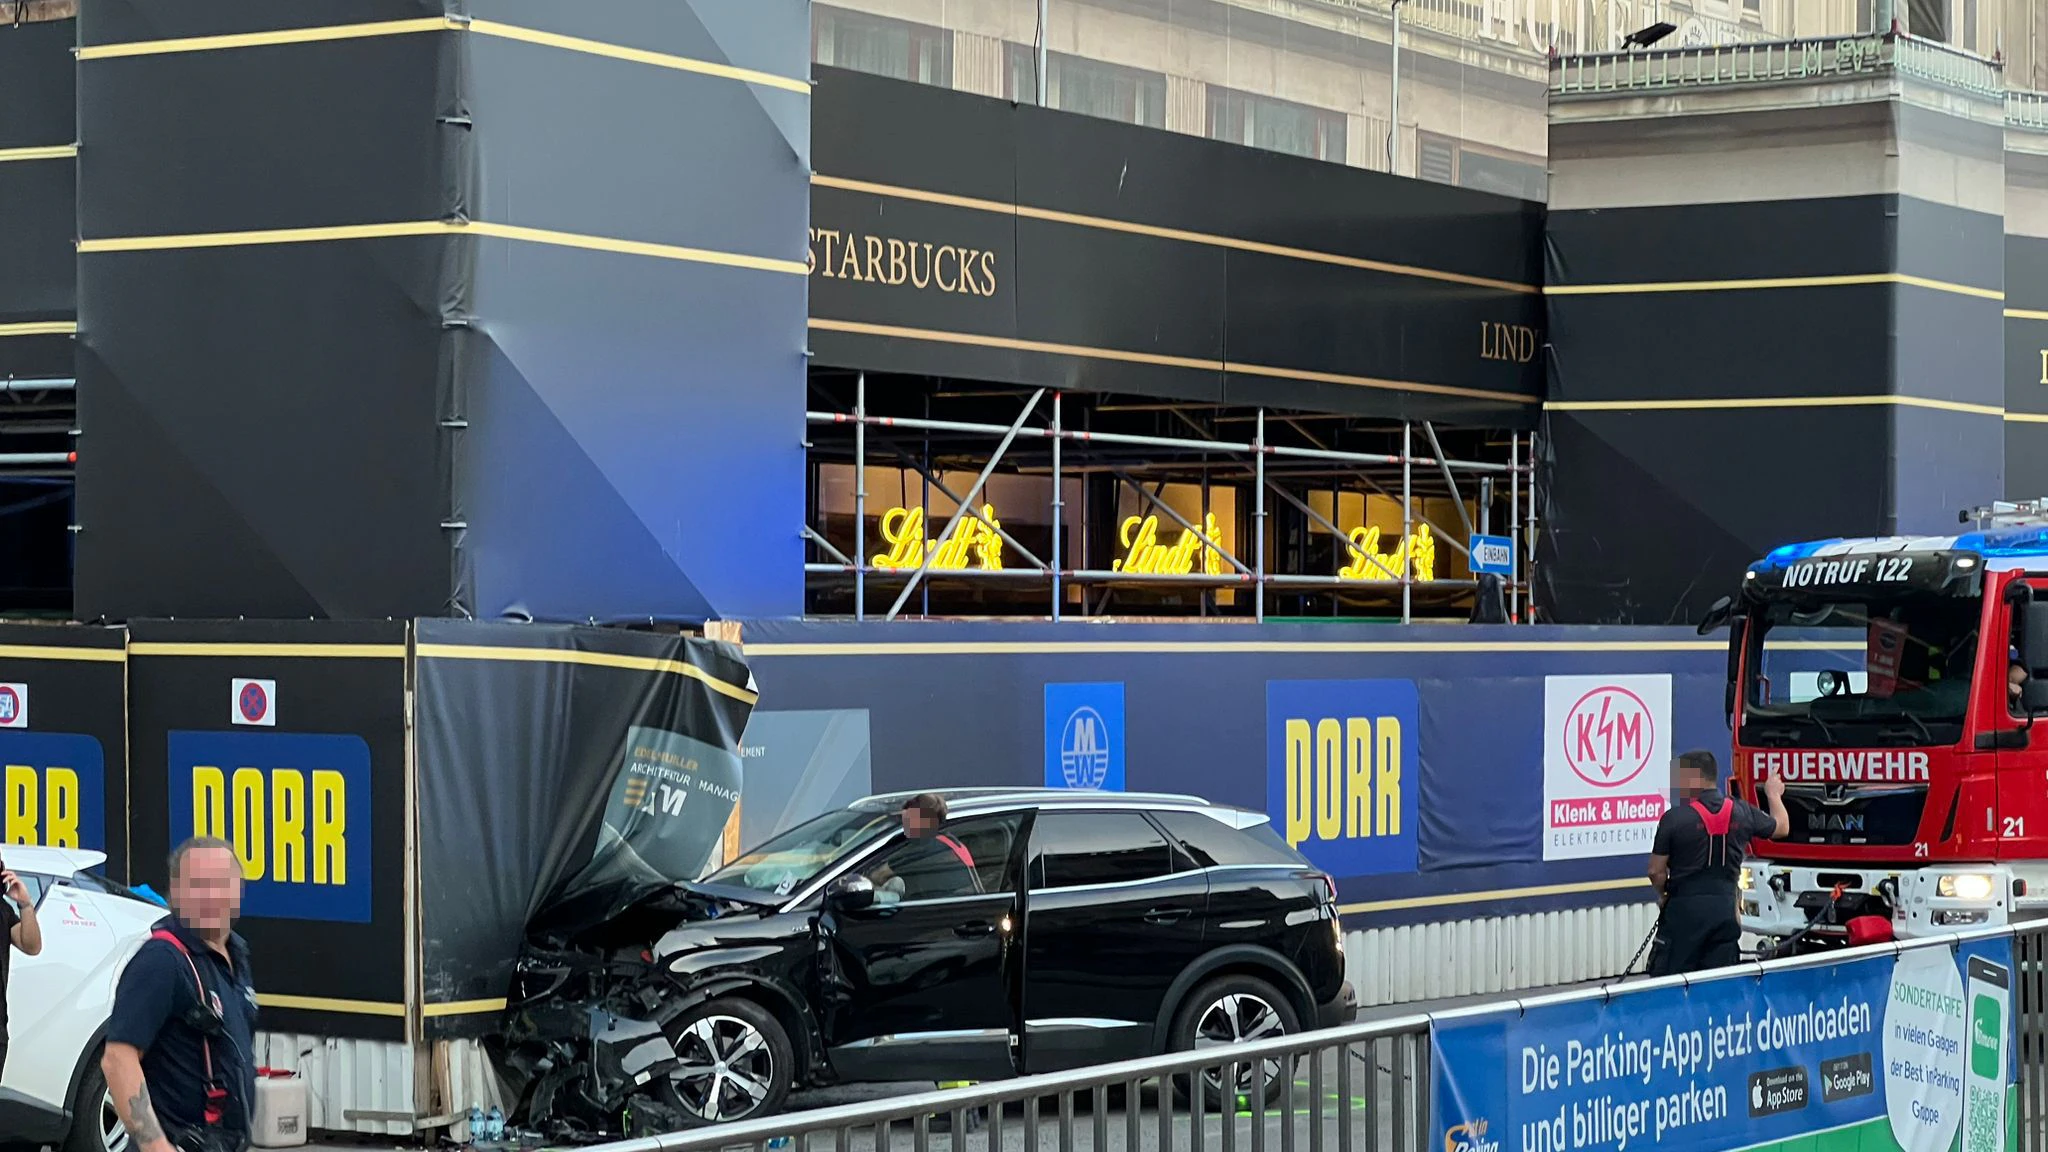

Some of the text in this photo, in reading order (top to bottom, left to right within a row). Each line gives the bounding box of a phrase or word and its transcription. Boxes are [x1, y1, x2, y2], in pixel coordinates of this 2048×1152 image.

[1480, 321, 1539, 362] LIND
[1113, 515, 1202, 575] Lindt
[1484, 546, 1508, 563] EINBAHN
[1782, 557, 1913, 588] NOTRUF 122
[1752, 751, 1930, 781] FEUERWEHR
[1554, 799, 1661, 824] Klenk & Meder
[1808, 813, 1865, 832] MAN
[1554, 827, 1654, 847] ELEKTROTECHNI
[2002, 815, 2025, 838] 21
[1913, 842, 1930, 858] 21
[1522, 996, 1871, 1094] Die Parking-App jetzt downloaden
[1902, 1023, 1926, 1046] vielen
[1833, 1069, 1870, 1092] Google Play
[1890, 1057, 1903, 1077] der
[1904, 1060, 1924, 1083] Best
[1766, 1086, 1803, 1110] App Store
[1522, 1080, 1727, 1152] und billiger parken
